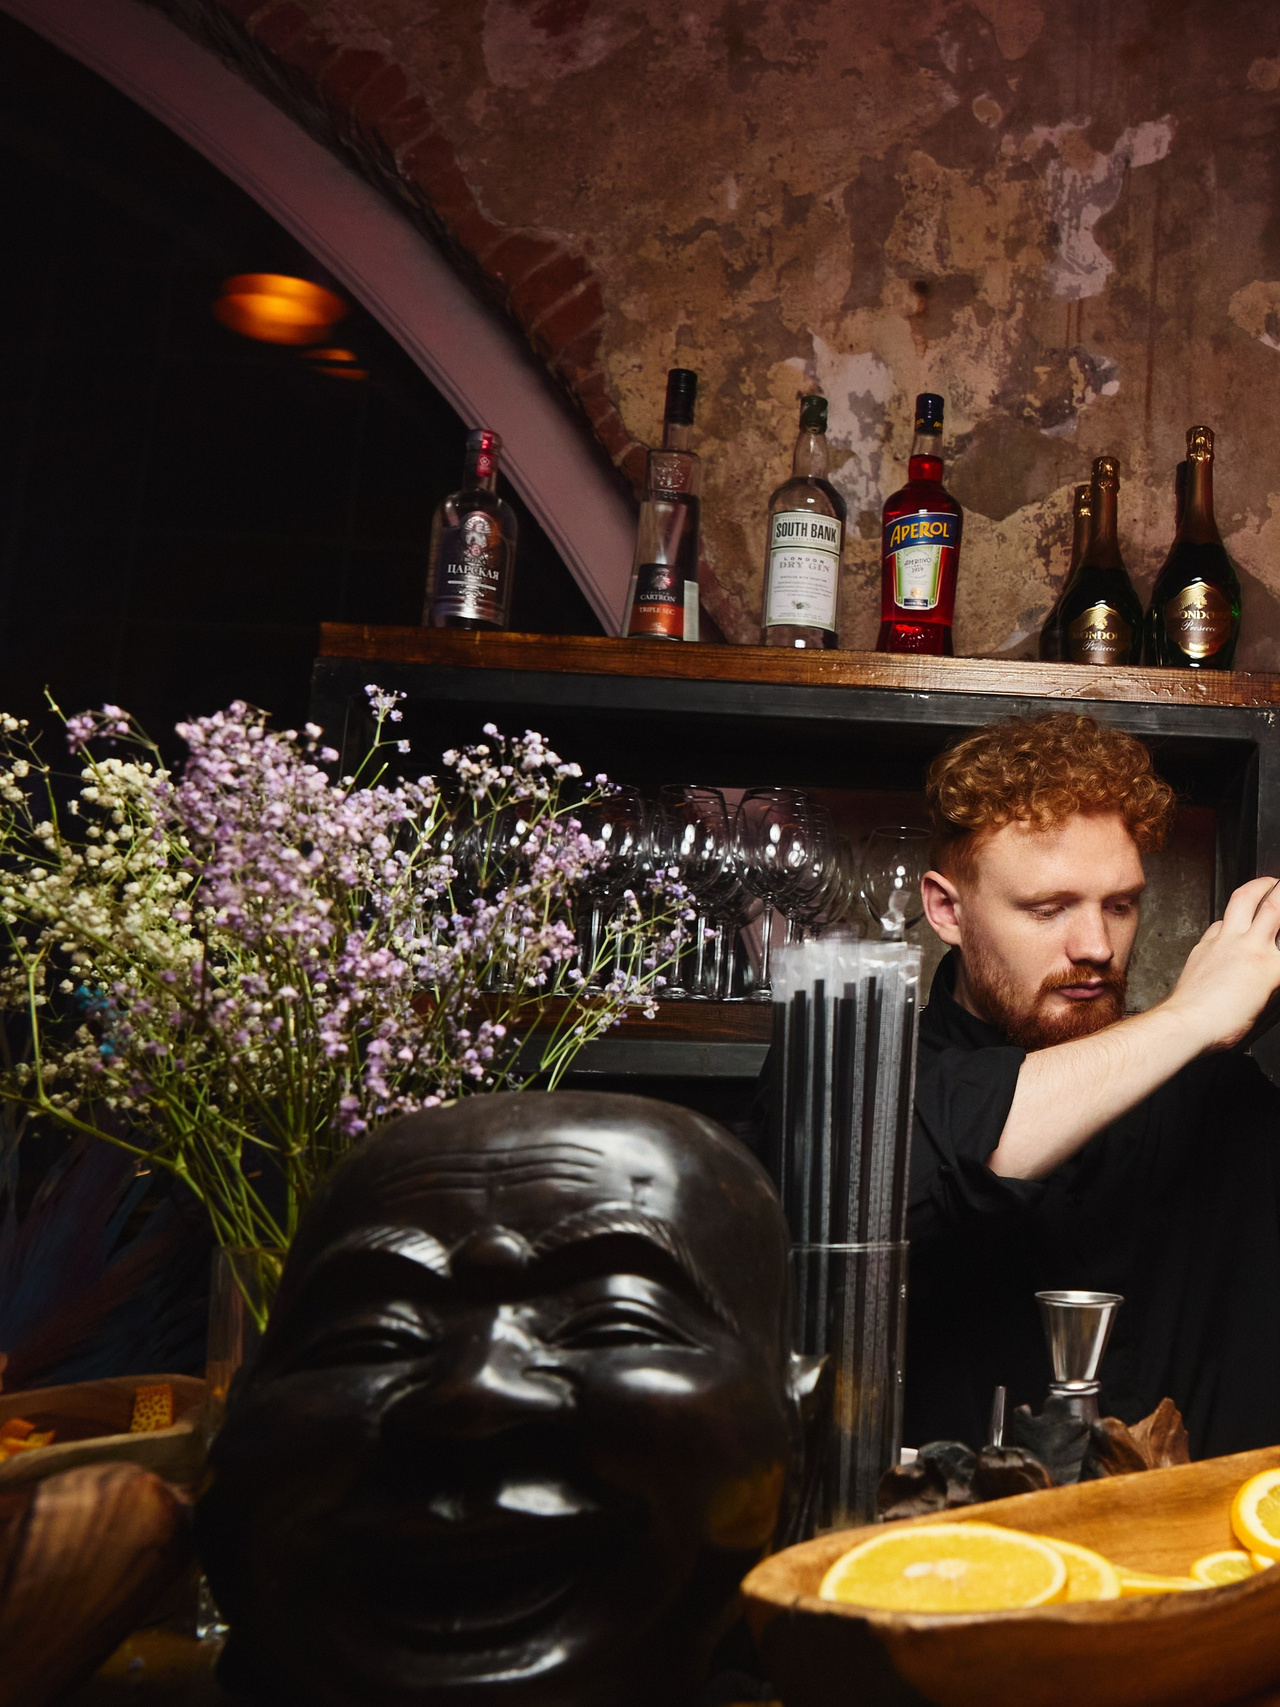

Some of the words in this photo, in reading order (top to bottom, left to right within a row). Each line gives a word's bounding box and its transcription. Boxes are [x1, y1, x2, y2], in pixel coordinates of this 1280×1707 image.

[776, 522, 808, 538] SOUTH
[811, 523, 837, 543] BANK
[890, 521, 949, 548] APEROL
[783, 556, 825, 564] LONDON
[447, 564, 500, 580] ЦАРСКАЯ
[779, 561, 803, 569] DRY
[808, 563, 830, 573] GIN
[640, 593, 677, 603] CARTRON
[639, 606, 660, 614] TRIPLE
[662, 607, 676, 616] SEC
